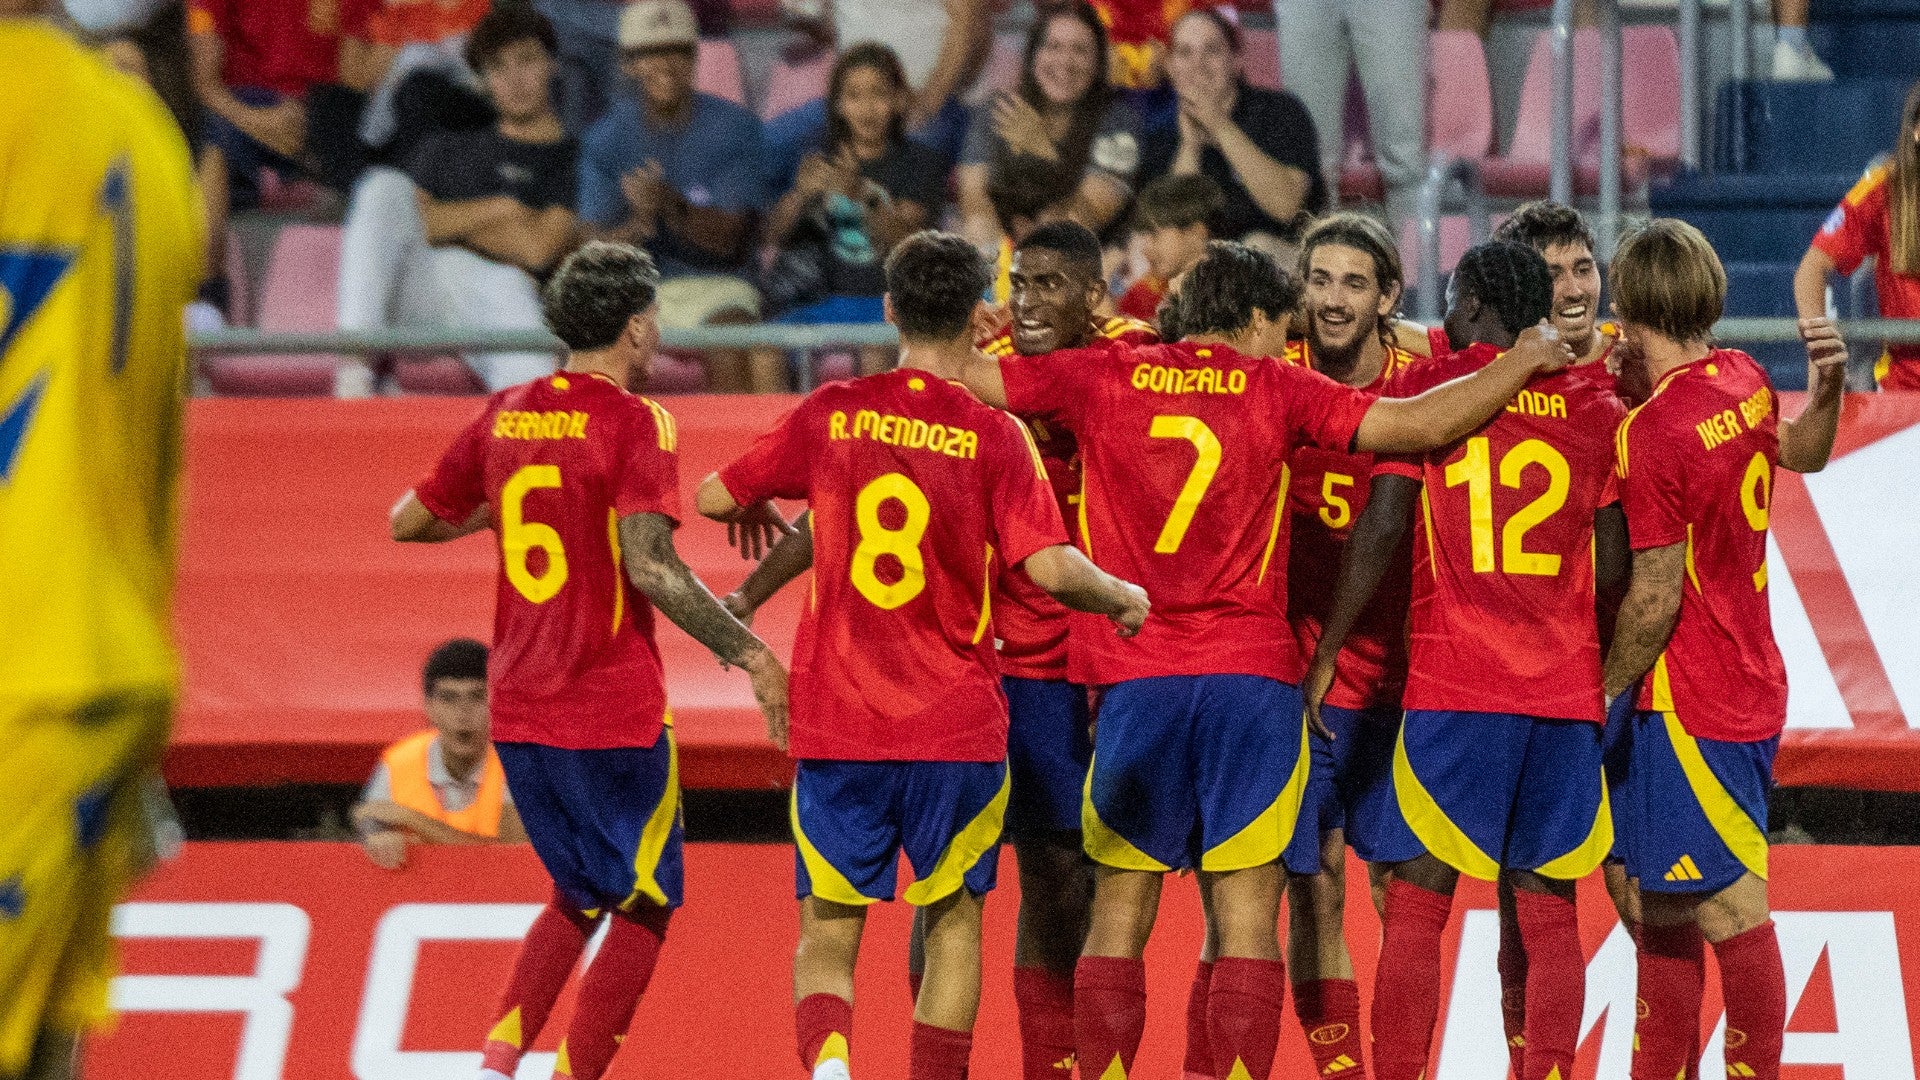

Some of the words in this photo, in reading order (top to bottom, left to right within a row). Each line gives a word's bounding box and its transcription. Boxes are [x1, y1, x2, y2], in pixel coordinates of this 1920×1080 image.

[1131, 363, 1247, 395] GONZALO
[1695, 409, 1743, 451] IKER
[501, 464, 568, 604] 6
[850, 472, 931, 610] 8
[1149, 415, 1223, 554] 7
[1318, 471, 1354, 529] 5
[1445, 436, 1571, 576] 12
[1739, 451, 1770, 592] 9
